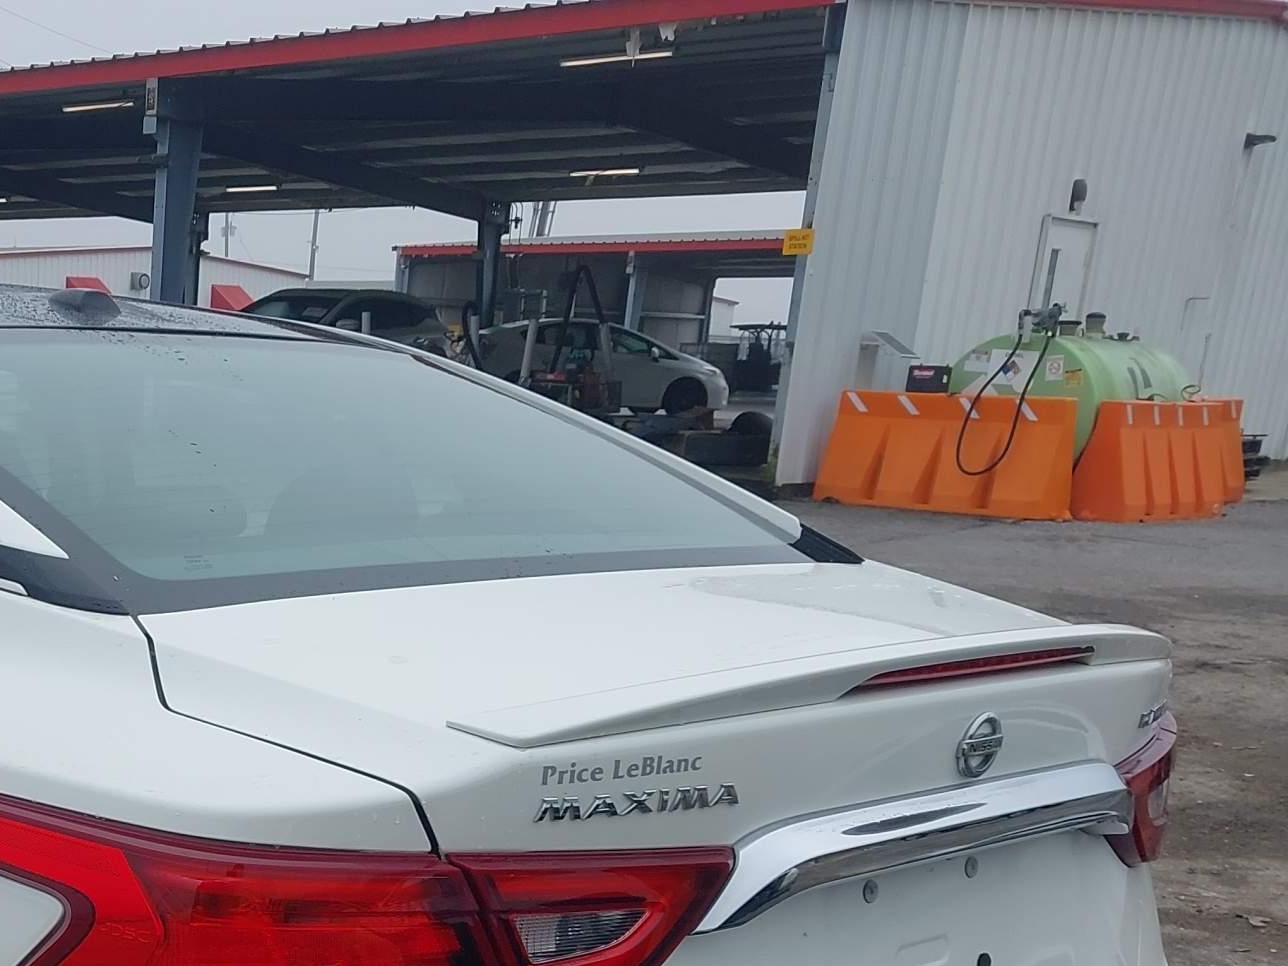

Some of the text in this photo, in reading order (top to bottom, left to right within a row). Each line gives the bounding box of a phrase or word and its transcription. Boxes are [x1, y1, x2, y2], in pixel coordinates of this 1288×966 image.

[541, 754, 703, 786] Price LeBlanc
[534, 782, 740, 822] MAXIMA
